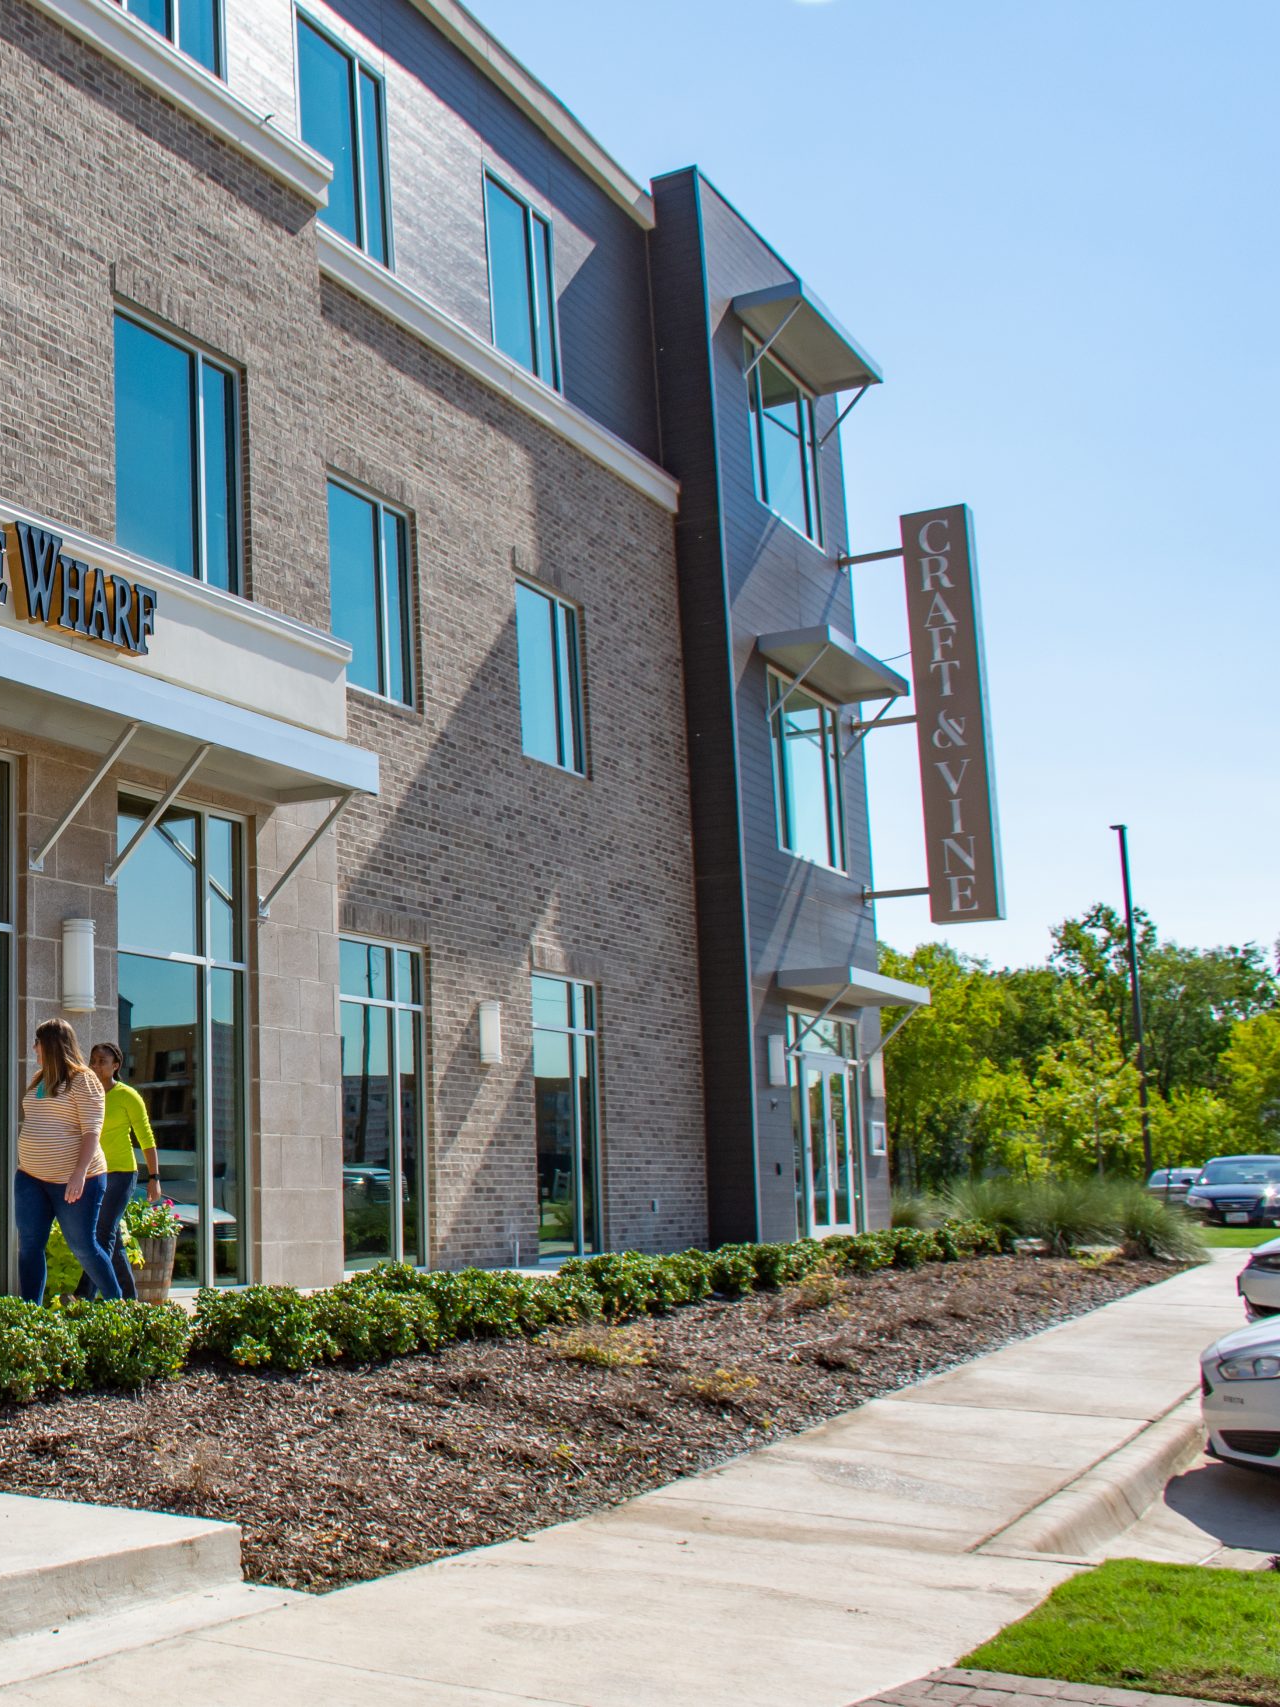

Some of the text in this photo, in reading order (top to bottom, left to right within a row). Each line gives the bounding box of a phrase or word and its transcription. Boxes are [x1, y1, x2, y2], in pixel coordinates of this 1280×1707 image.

[14, 520, 157, 656] WHARF
[917, 519, 961, 697] CRAFT
[934, 759, 979, 912] VINE
